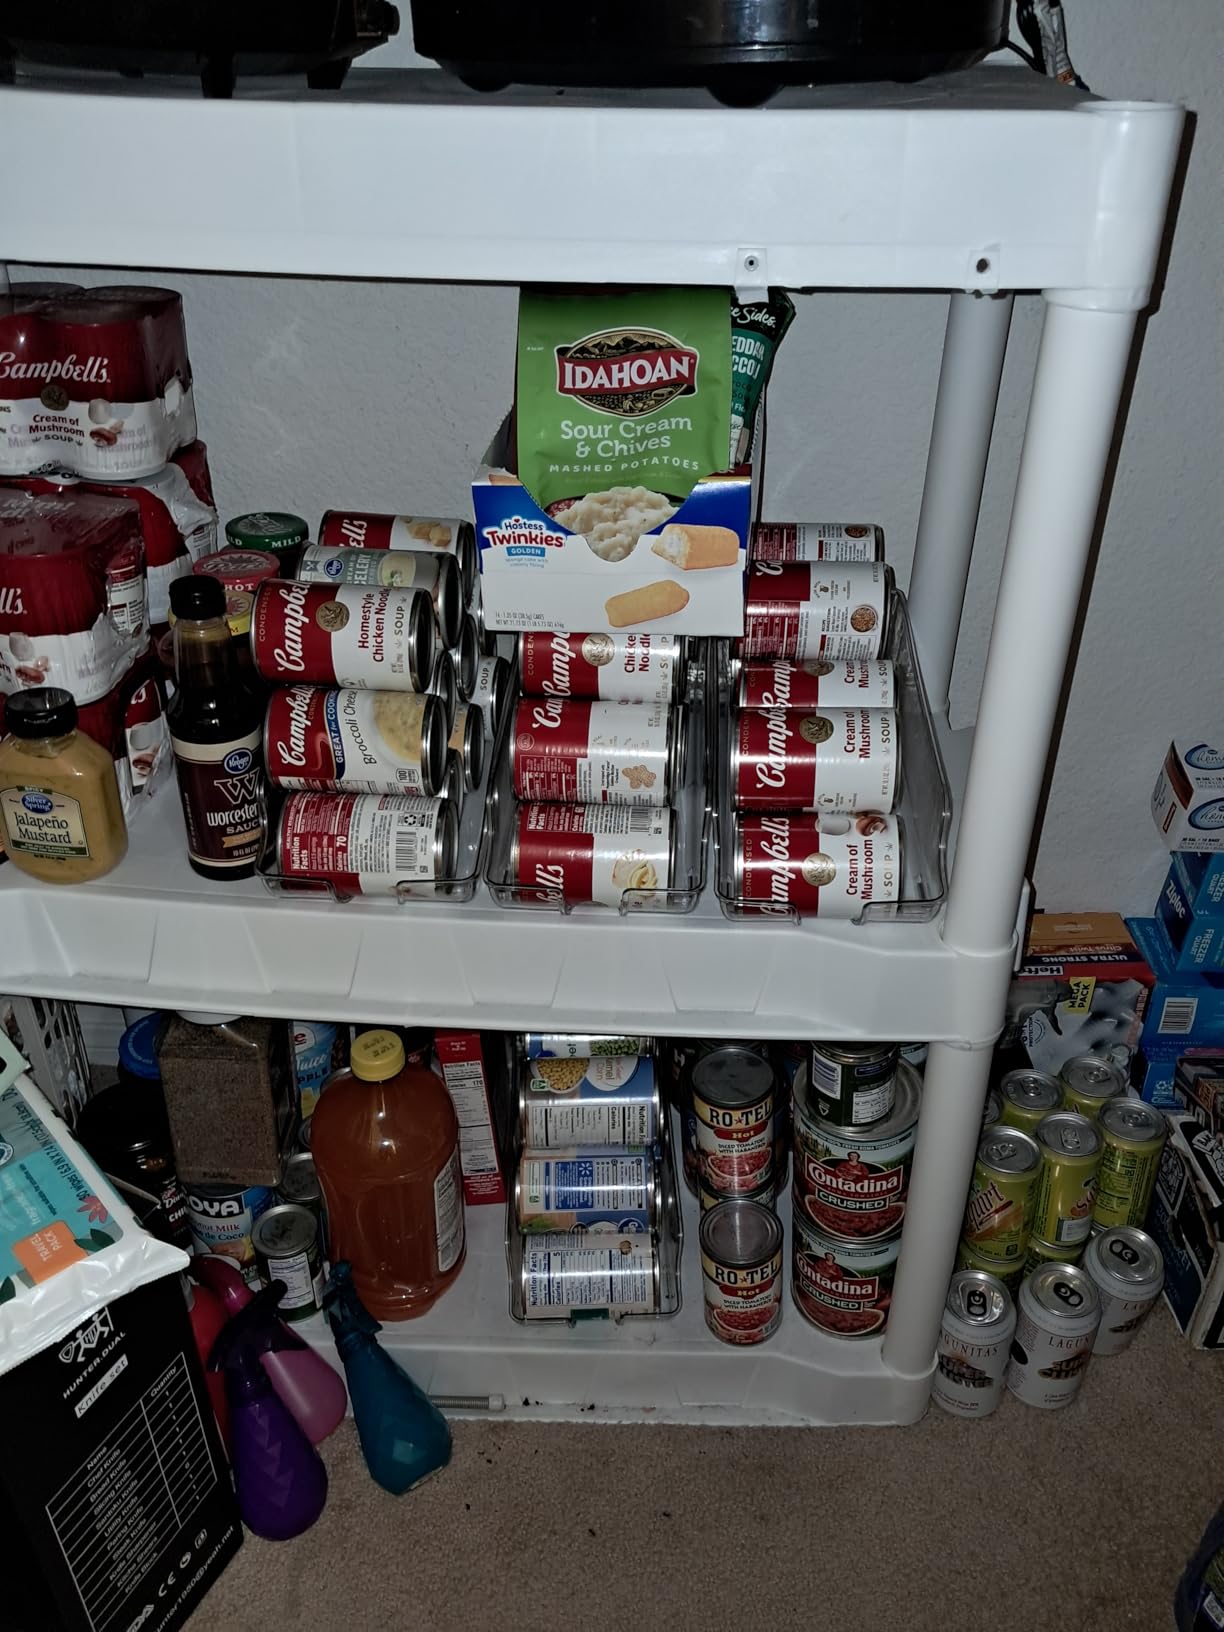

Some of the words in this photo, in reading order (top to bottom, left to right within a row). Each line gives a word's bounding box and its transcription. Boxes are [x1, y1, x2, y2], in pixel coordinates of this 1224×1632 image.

[732, 335, 765, 362] EDDAR
[564, 356, 691, 390] IDAHOAN
[29, 424, 84, 438] Mushroom
[33, 414, 67, 424] Cream
[69, 417, 79, 426] of
[560, 419, 613, 440] Sour
[619, 415, 693, 439] Cream
[44, 434, 74, 443] SOUP
[575, 440, 591, 458] &
[596, 434, 671, 458] Chives
[549, 462, 613, 473] MASHED
[621, 455, 700, 471] POTATOES
[504, 521, 544, 531] Hostess
[271, 536, 302, 549] MILD
[486, 530, 564, 548] Twinkies
[224, 583, 254, 592] HOT
[357, 593, 375, 649] Homestyle
[395, 606, 405, 636] SOUP
[373, 620, 385, 663] Chicken
[480, 667, 490, 690] SOUP
[843, 720, 856, 753] Cream
[881, 717, 890, 744] SOUP
[335, 734, 345, 763] GREAT
[350, 718, 377, 766] Broccoli
[228, 755, 250, 771] Kroger
[15, 812, 69, 831] Jalapeño
[226, 820, 259, 834] SAUC
[536, 812, 546, 829] Facts
[19, 827, 72, 845] Mustard
[336, 835, 347, 847] 70
[292, 836, 300, 869] Nutrition
[299, 849, 309, 869] Facts
[847, 844, 858, 857] of
[846, 859, 858, 896] Cream
[861, 839, 874, 900] Mushroom
[1166, 880, 1187, 920] Ziploc
[1194, 928, 1215, 964] FREEZER
[1089, 954, 1128, 962] ULTRA
[1068, 981, 1082, 1008] MEGA
[1078, 983, 1090, 1008] PACK
[609, 1106, 617, 1129] Calories
[637, 1105, 646, 1134] Nutrition
[731, 1130, 755, 1139] Hot
[808, 1162, 898, 1193] Contadina
[188, 1195, 240, 1217] OYA
[819, 1191, 885, 1210] CRUSHED
[216, 1223, 240, 1232] Milk
[218, 1232, 244, 1241] Coco
[30, 1233, 52, 1262] TRAVEL
[44, 1230, 63, 1251] PACK
[529, 1252, 537, 1272] Facts
[528, 1275, 538, 1306] Nutrition
[736, 1288, 760, 1297] Hot
[802, 1280, 859, 1309] CRUSHED
[78, 1382, 106, 1414] Knife
[109, 1360, 126, 1379] set
[86, 1446, 107, 1471] Name
[150, 1365, 177, 1397] Quantity
[87, 1465, 104, 1488] Chef
[104, 1448, 121, 1472] Knife
[110, 1458, 127, 1480] Knife
[115, 1470, 132, 1491] Knife
[121, 1479, 139, 1500] Knife
[121, 1496, 138, 1517] Knife
[127, 1505, 144, 1527] Knife
[130, 1518, 147, 1538] Knife
[124, 1573, 142, 1594] Knife
